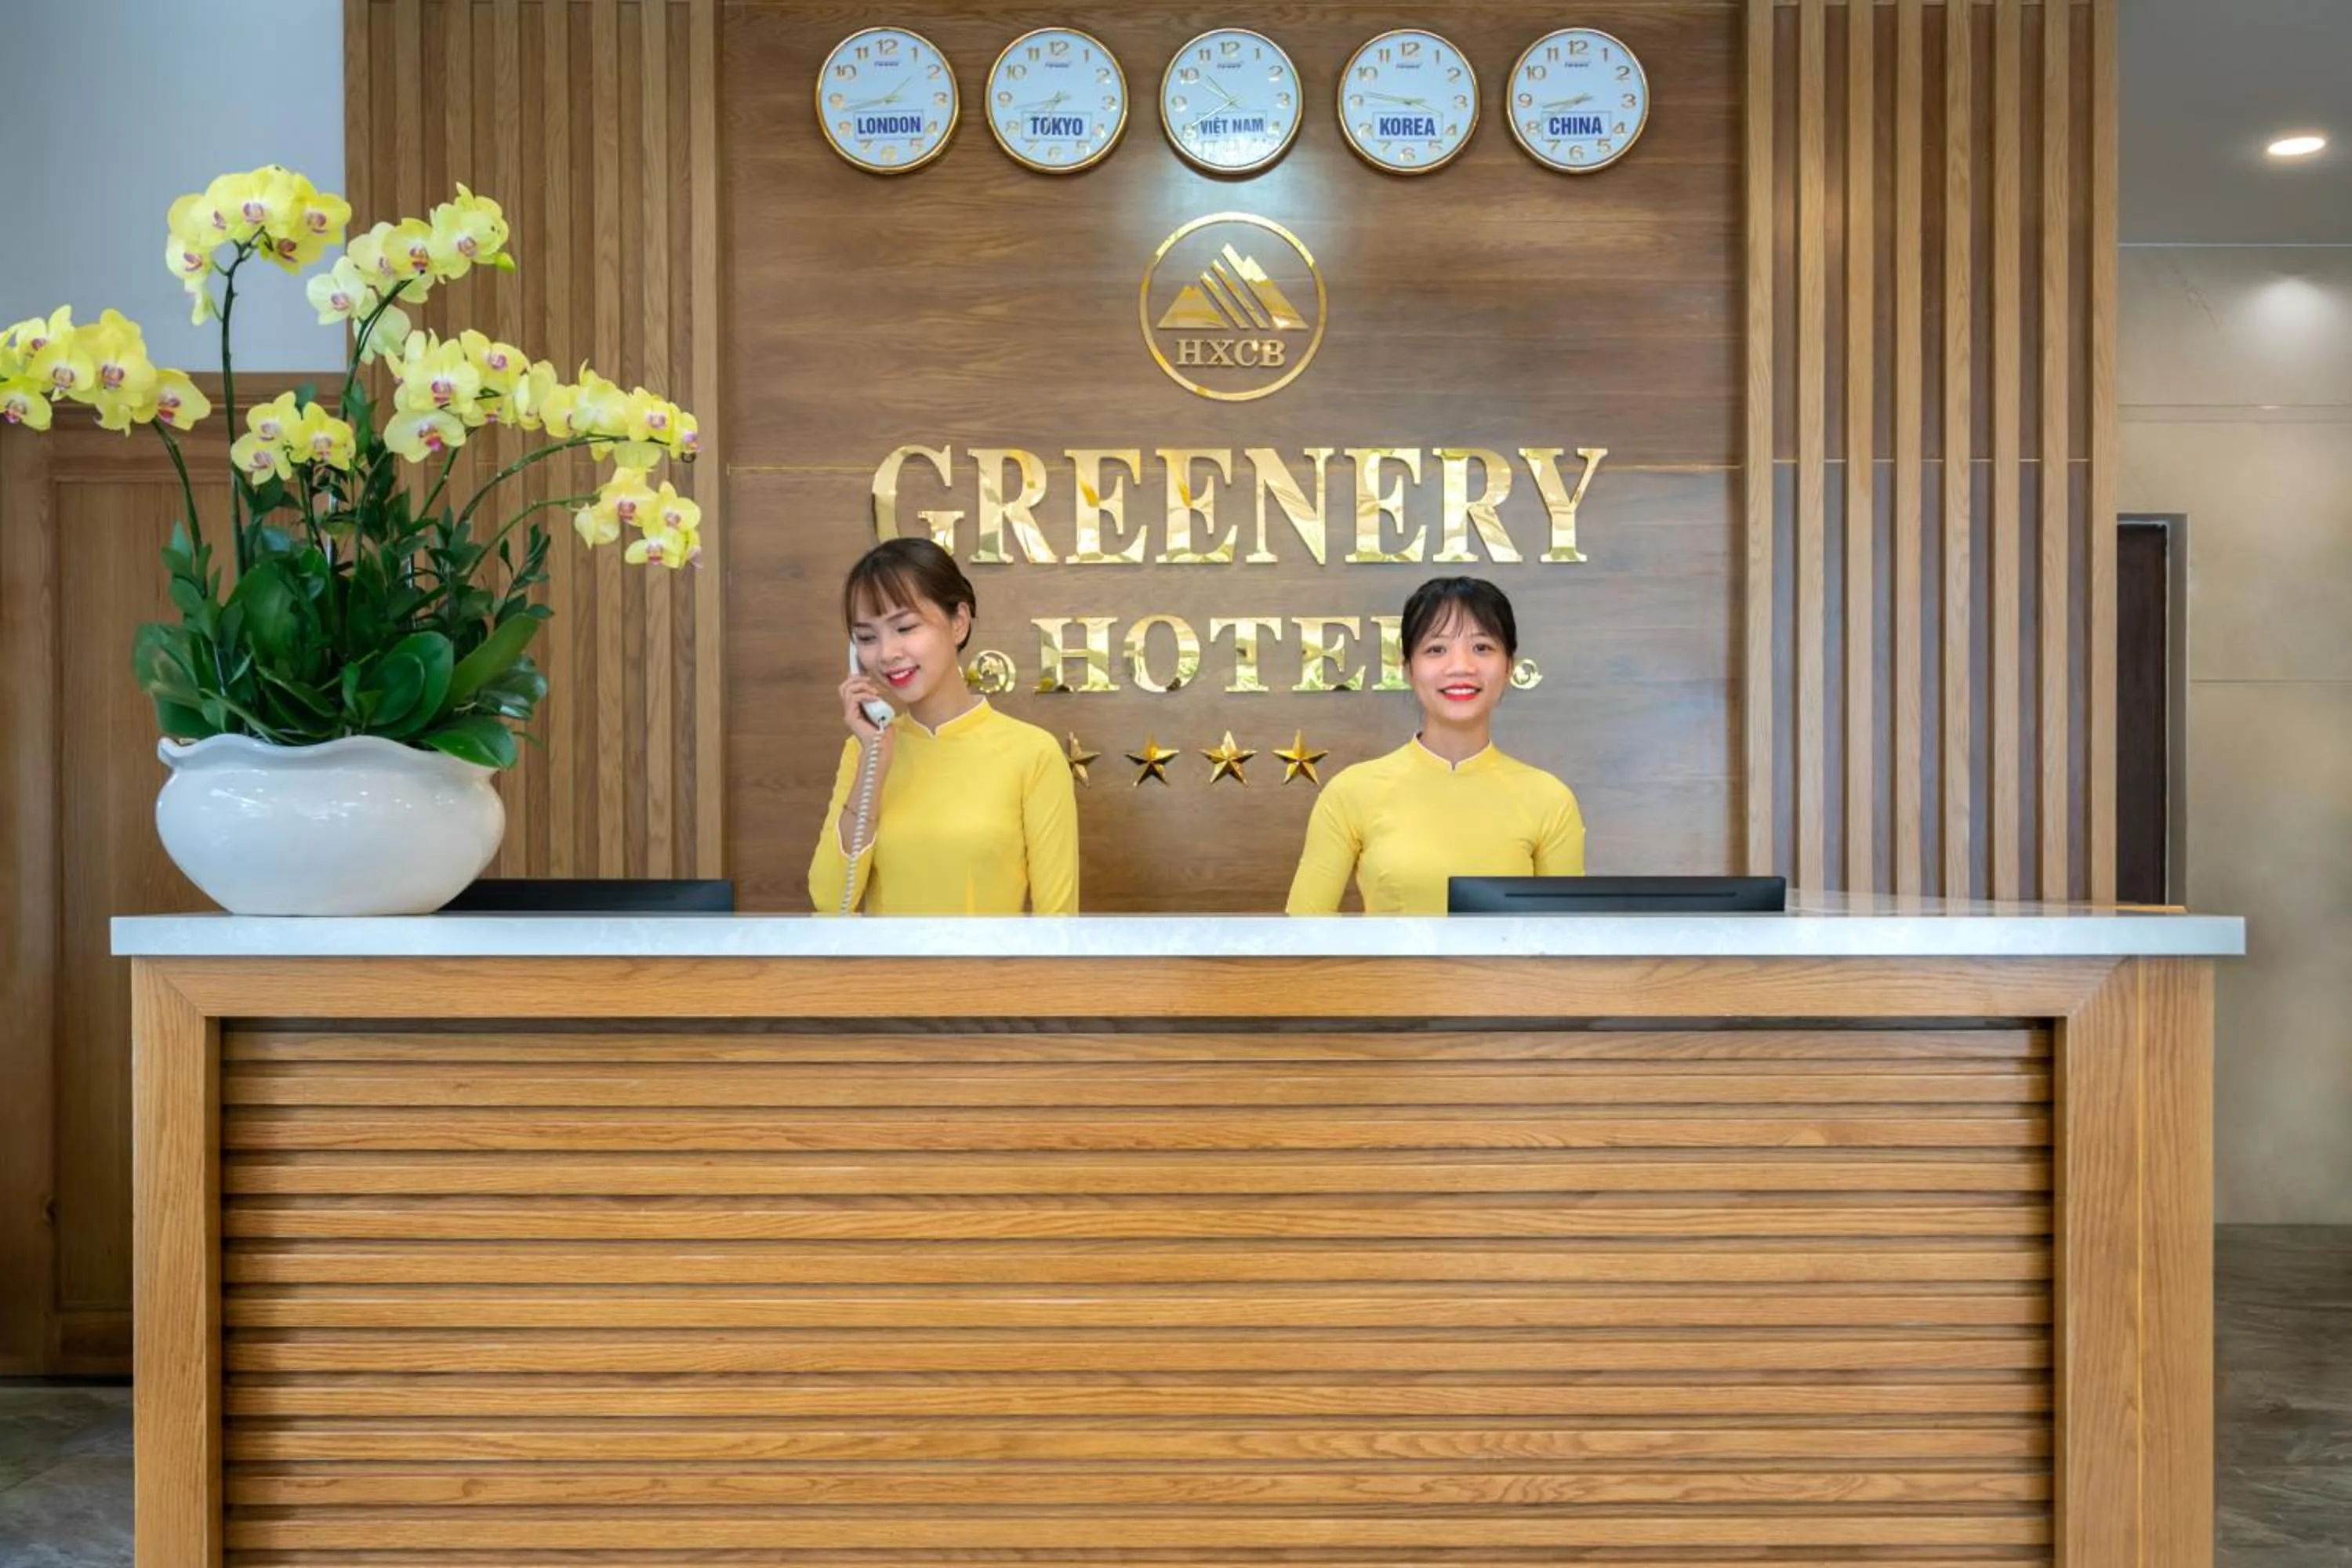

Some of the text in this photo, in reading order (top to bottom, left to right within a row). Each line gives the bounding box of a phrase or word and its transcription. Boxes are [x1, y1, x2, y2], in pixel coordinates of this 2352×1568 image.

[855, 46, 869, 60] 11
[877, 39, 898, 56] 12
[911, 46, 918, 63] 1
[1026, 48, 1040, 60] 11
[1049, 41, 1069, 56] 12
[1220, 41, 1240, 57] 12
[1255, 48, 1261, 62] 1
[1401, 42, 1420, 57] 12
[1546, 47, 1559, 61] 11
[1568, 40, 1588, 56] 12
[1083, 49, 1089, 63] 1
[1199, 49, 1211, 62] 11
[1378, 49, 1390, 63] 11
[1436, 49, 1439, 64] 1
[1602, 48, 1608, 63] 1
[835, 64, 857, 81] 10
[927, 64, 941, 80] 2
[1006, 64, 1027, 80] 10
[1179, 67, 1200, 85] 10
[1358, 67, 1377, 81] 10
[1446, 67, 1461, 82] 2
[1526, 65, 1546, 80] 10
[1616, 66, 1631, 80] 2
[933, 91, 948, 107] 3
[1518, 93, 1533, 108] 9
[1621, 93, 1636, 108] 3
[858, 116, 920, 134] LONDON
[1030, 118, 1083, 136] TOKYO
[1232, 118, 1264, 132] NAM
[1380, 118, 1436, 136] KOREA
[1549, 117, 1602, 136] CHINA
[1546, 140, 1560, 154] 7
[1177, 339, 1286, 367] HXCB
[871, 445, 1608, 564] GREENERY
